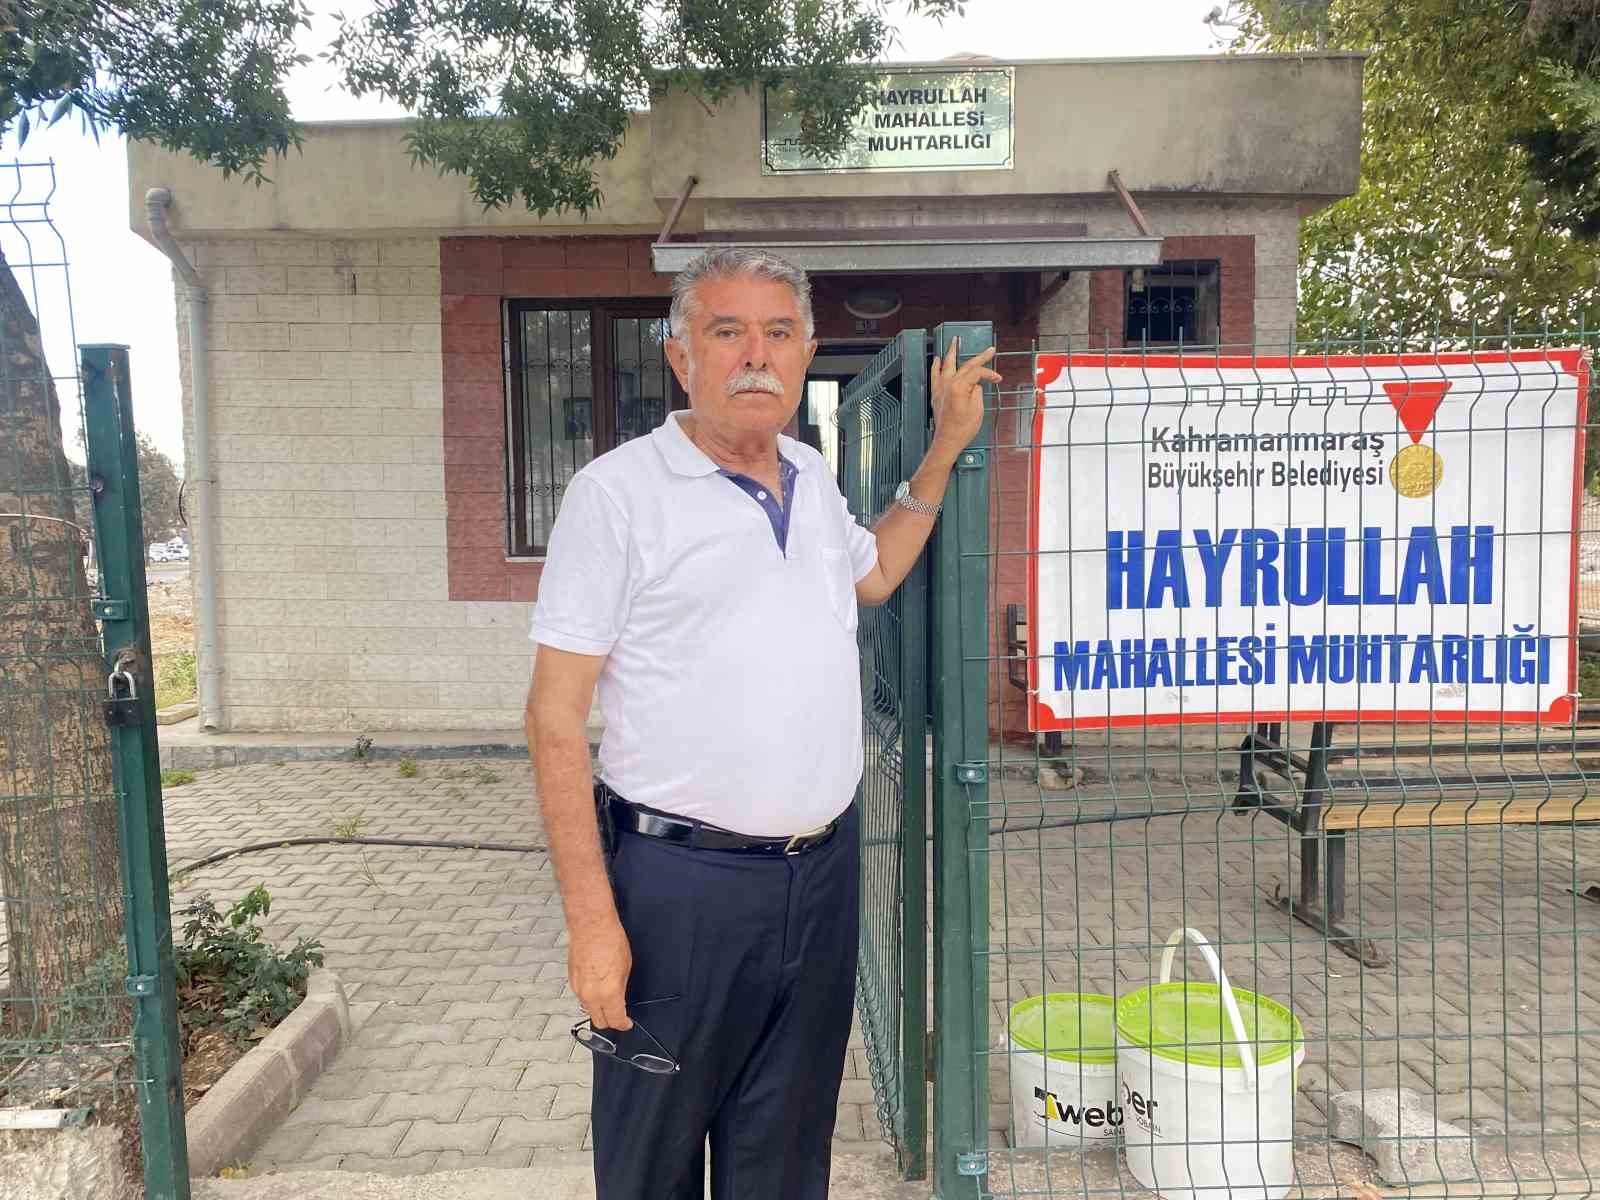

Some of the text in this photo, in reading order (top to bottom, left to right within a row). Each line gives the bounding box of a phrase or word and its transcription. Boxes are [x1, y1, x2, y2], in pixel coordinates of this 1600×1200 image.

[1151, 426, 1385, 457] Kahramanmaraş
[1148, 460, 1384, 494] Büyükşehir Belediyesi
[1106, 526, 1494, 609] HAYRULLAH
[1053, 623, 1550, 691] MAHALLESİ MUHTARLIĞI
